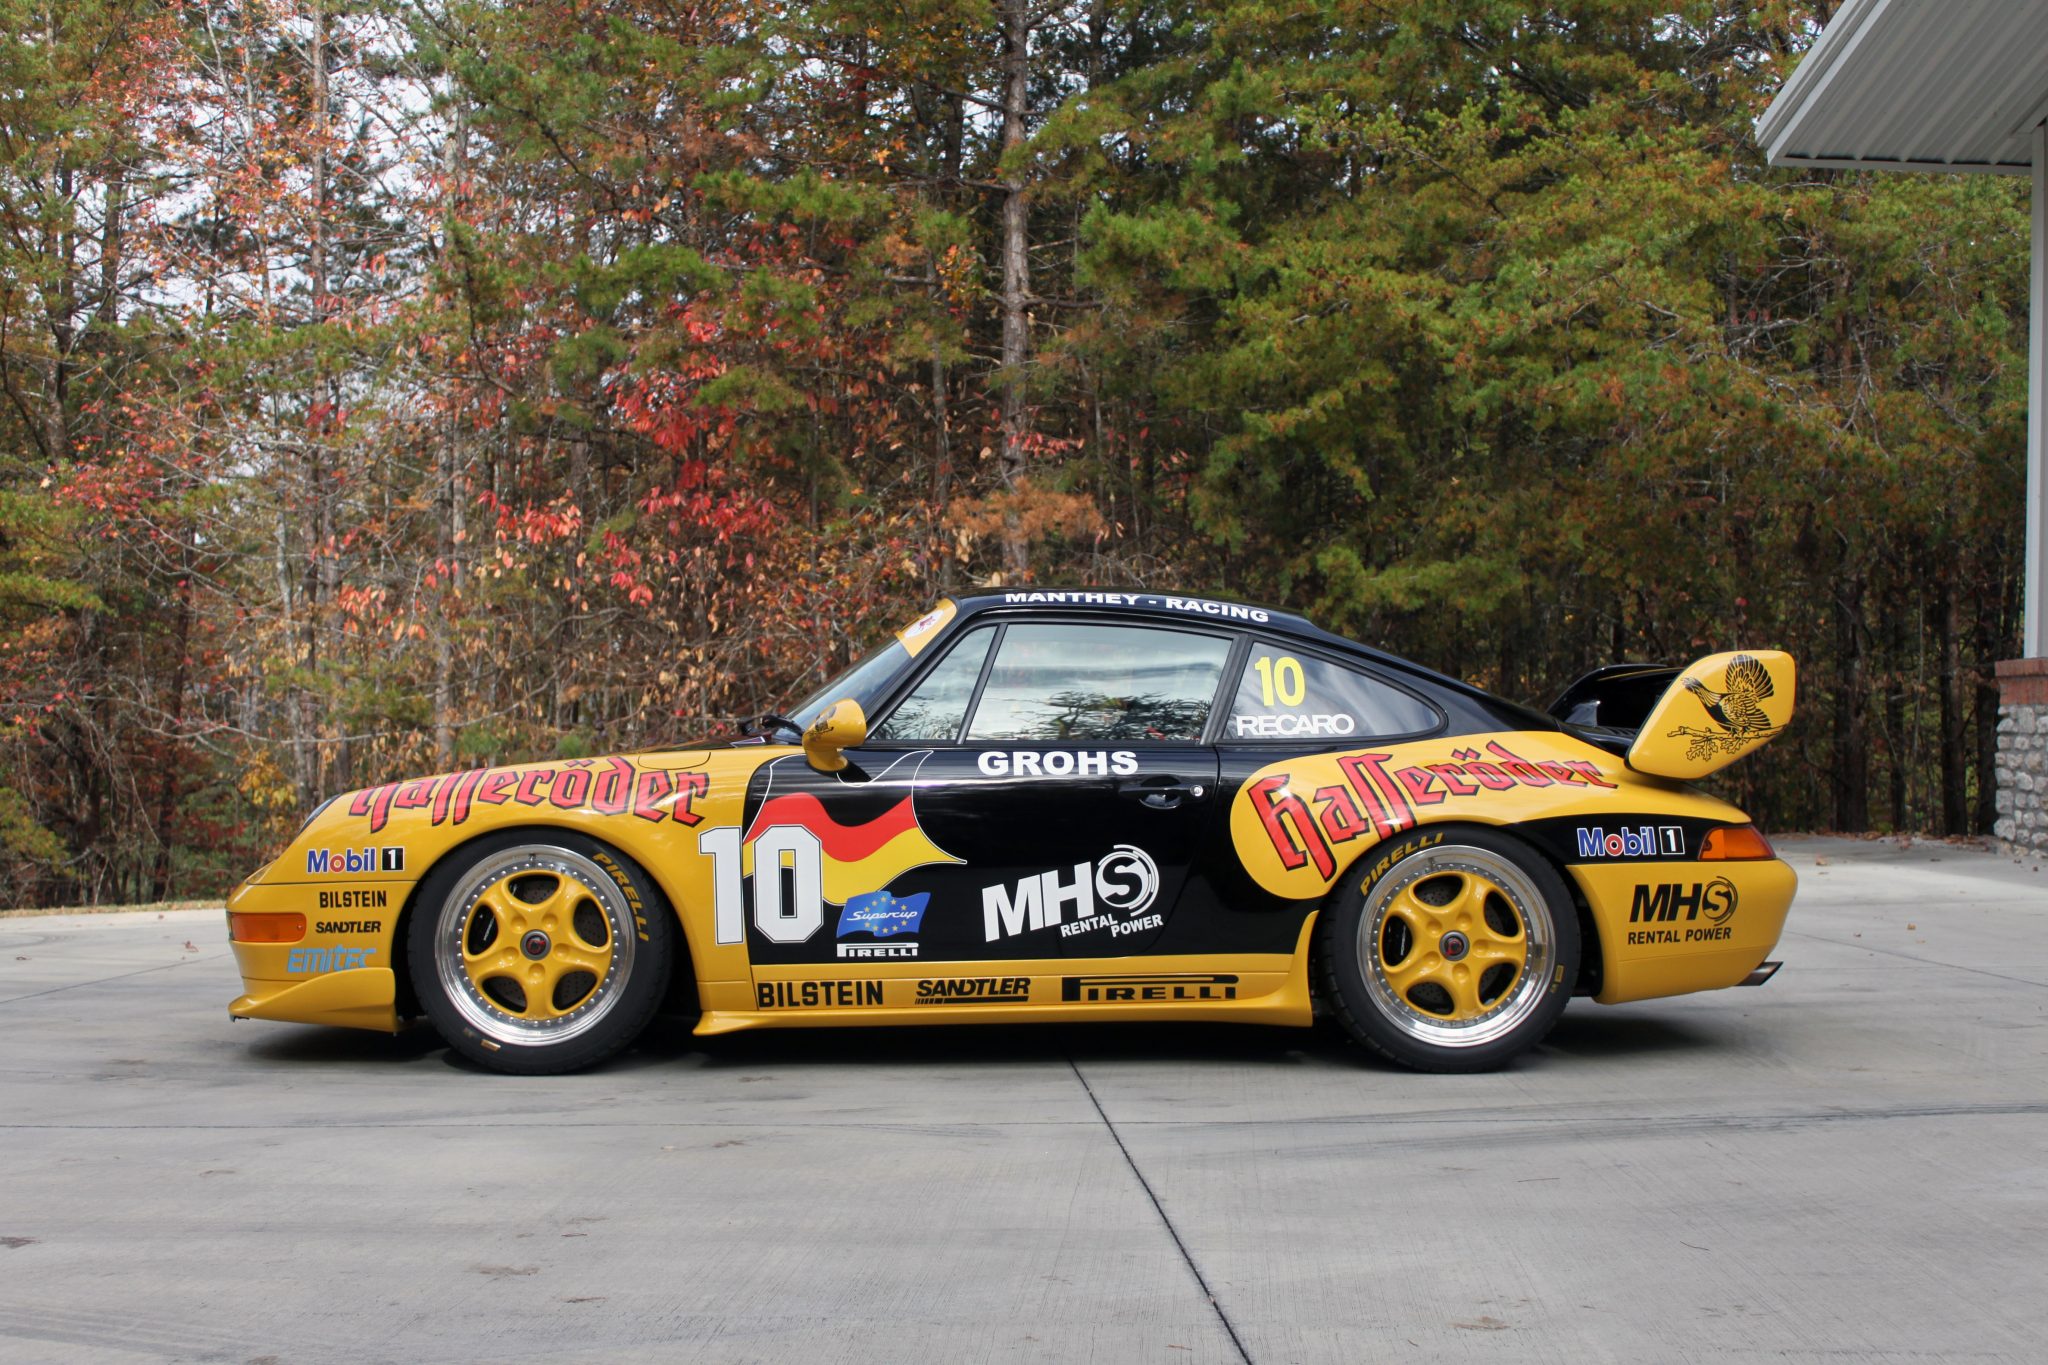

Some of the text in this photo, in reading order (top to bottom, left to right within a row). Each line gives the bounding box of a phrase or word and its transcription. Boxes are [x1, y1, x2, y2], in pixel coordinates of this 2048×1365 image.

[1005, 592, 1141, 607] MANTHEY
[1166, 597, 1270, 623] RACING
[1254, 656, 1306, 708] 10
[1236, 713, 1355, 737] RECARO
[977, 750, 1139, 776] GROHS
[1576, 826, 1656, 857] Mobil
[307, 847, 376, 874] Mobil
[1360, 832, 1444, 896] PIRELLI
[592, 853, 649, 941] PIRELLI
[699, 824, 824, 945] 10
[982, 844, 1160, 943] MHS
[319, 890, 387, 908] BILSTEIN
[1629, 875, 1738, 926] MHS
[315, 921, 381, 934] SANDTLER
[846, 911, 917, 922] Supercup
[1060, 913, 1118, 938] RENTAL
[1110, 913, 1164, 938] POWER
[837, 942, 919, 957] PIRELLI
[1628, 927, 1732, 945] RENTAL POWER
[758, 980, 883, 1008] BILSTEIN
[915, 977, 1031, 997] SANDTLER
[1061, 974, 1239, 1001] PIRELLI
